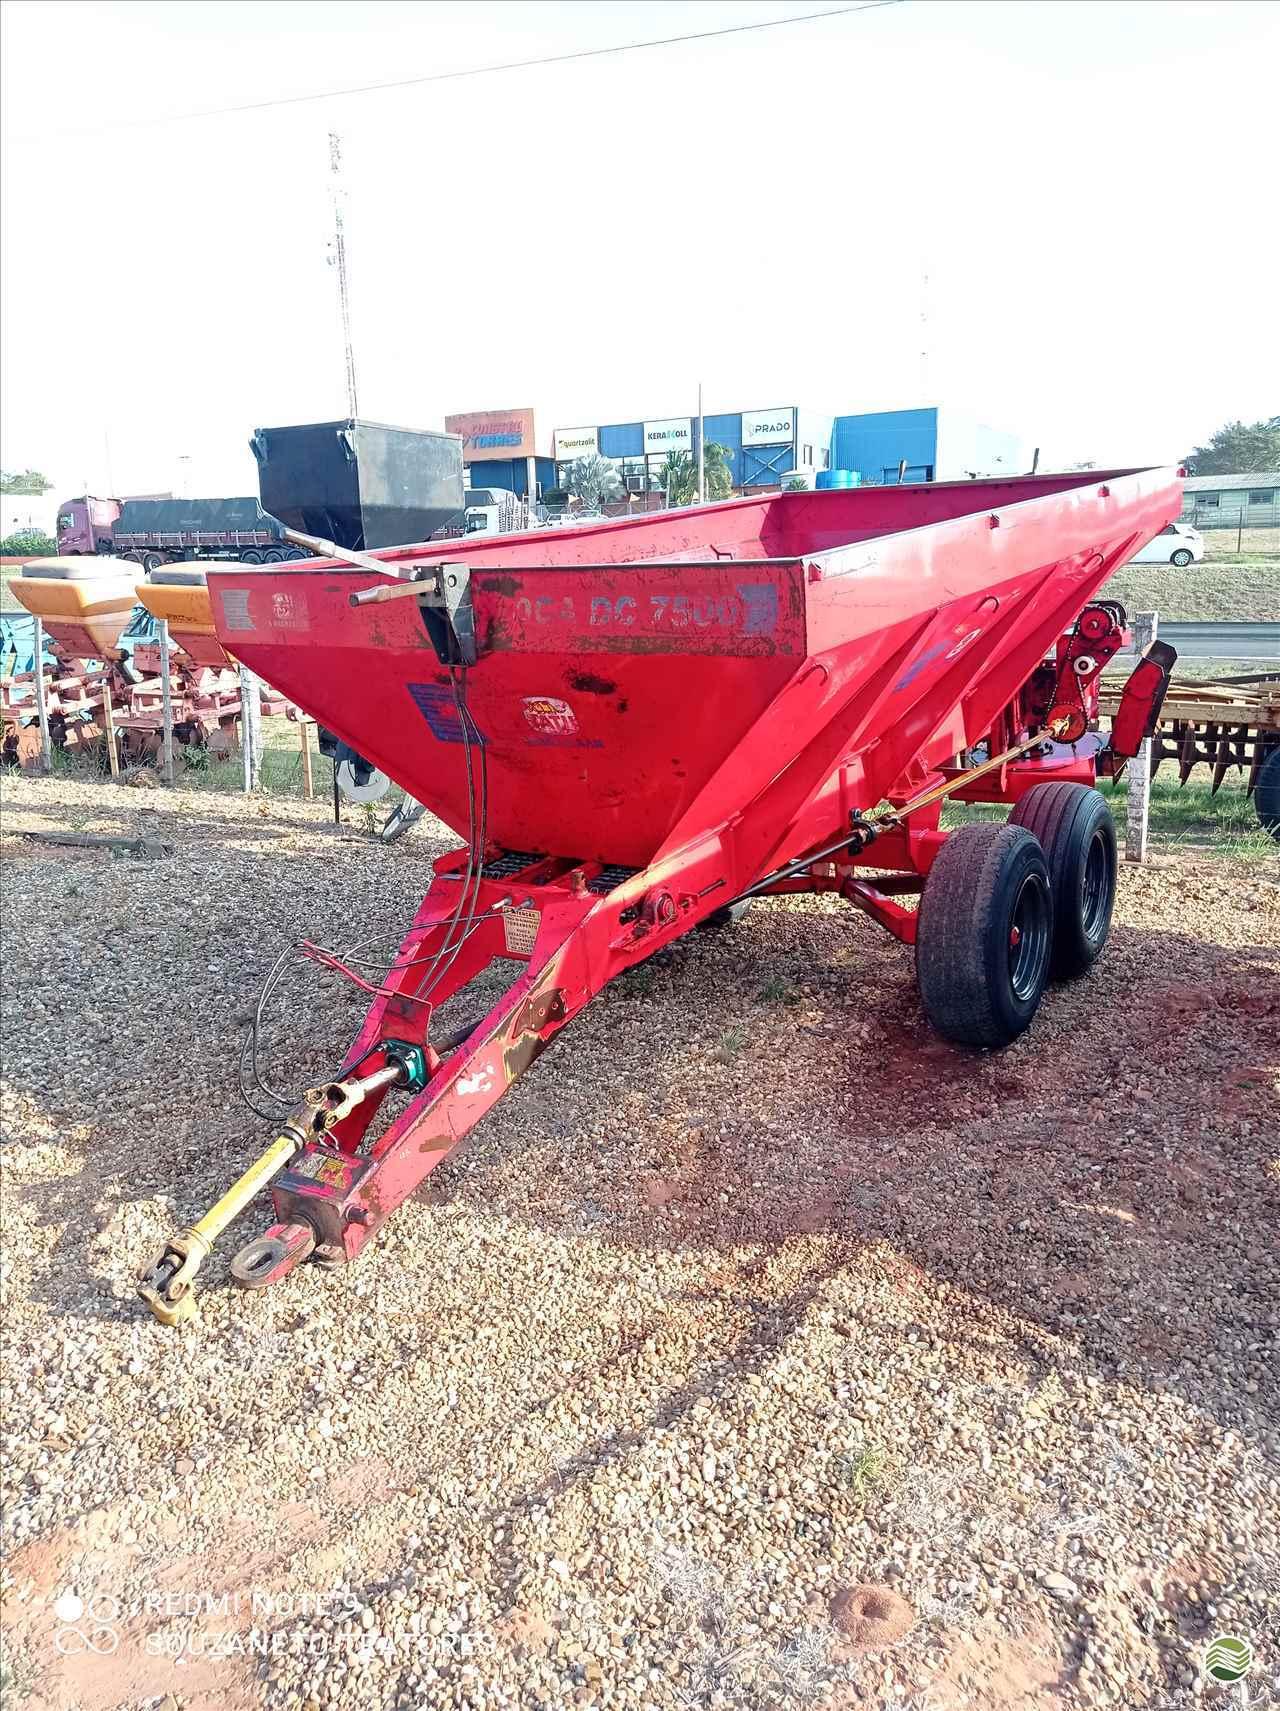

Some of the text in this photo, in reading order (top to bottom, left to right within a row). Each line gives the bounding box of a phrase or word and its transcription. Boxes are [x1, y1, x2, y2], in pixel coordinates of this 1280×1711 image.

[755, 422, 790, 433] PRADO
[563, 437, 596, 448] quartzolit
[590, 596, 637, 625] DC
[650, 595, 737, 627] 7500
